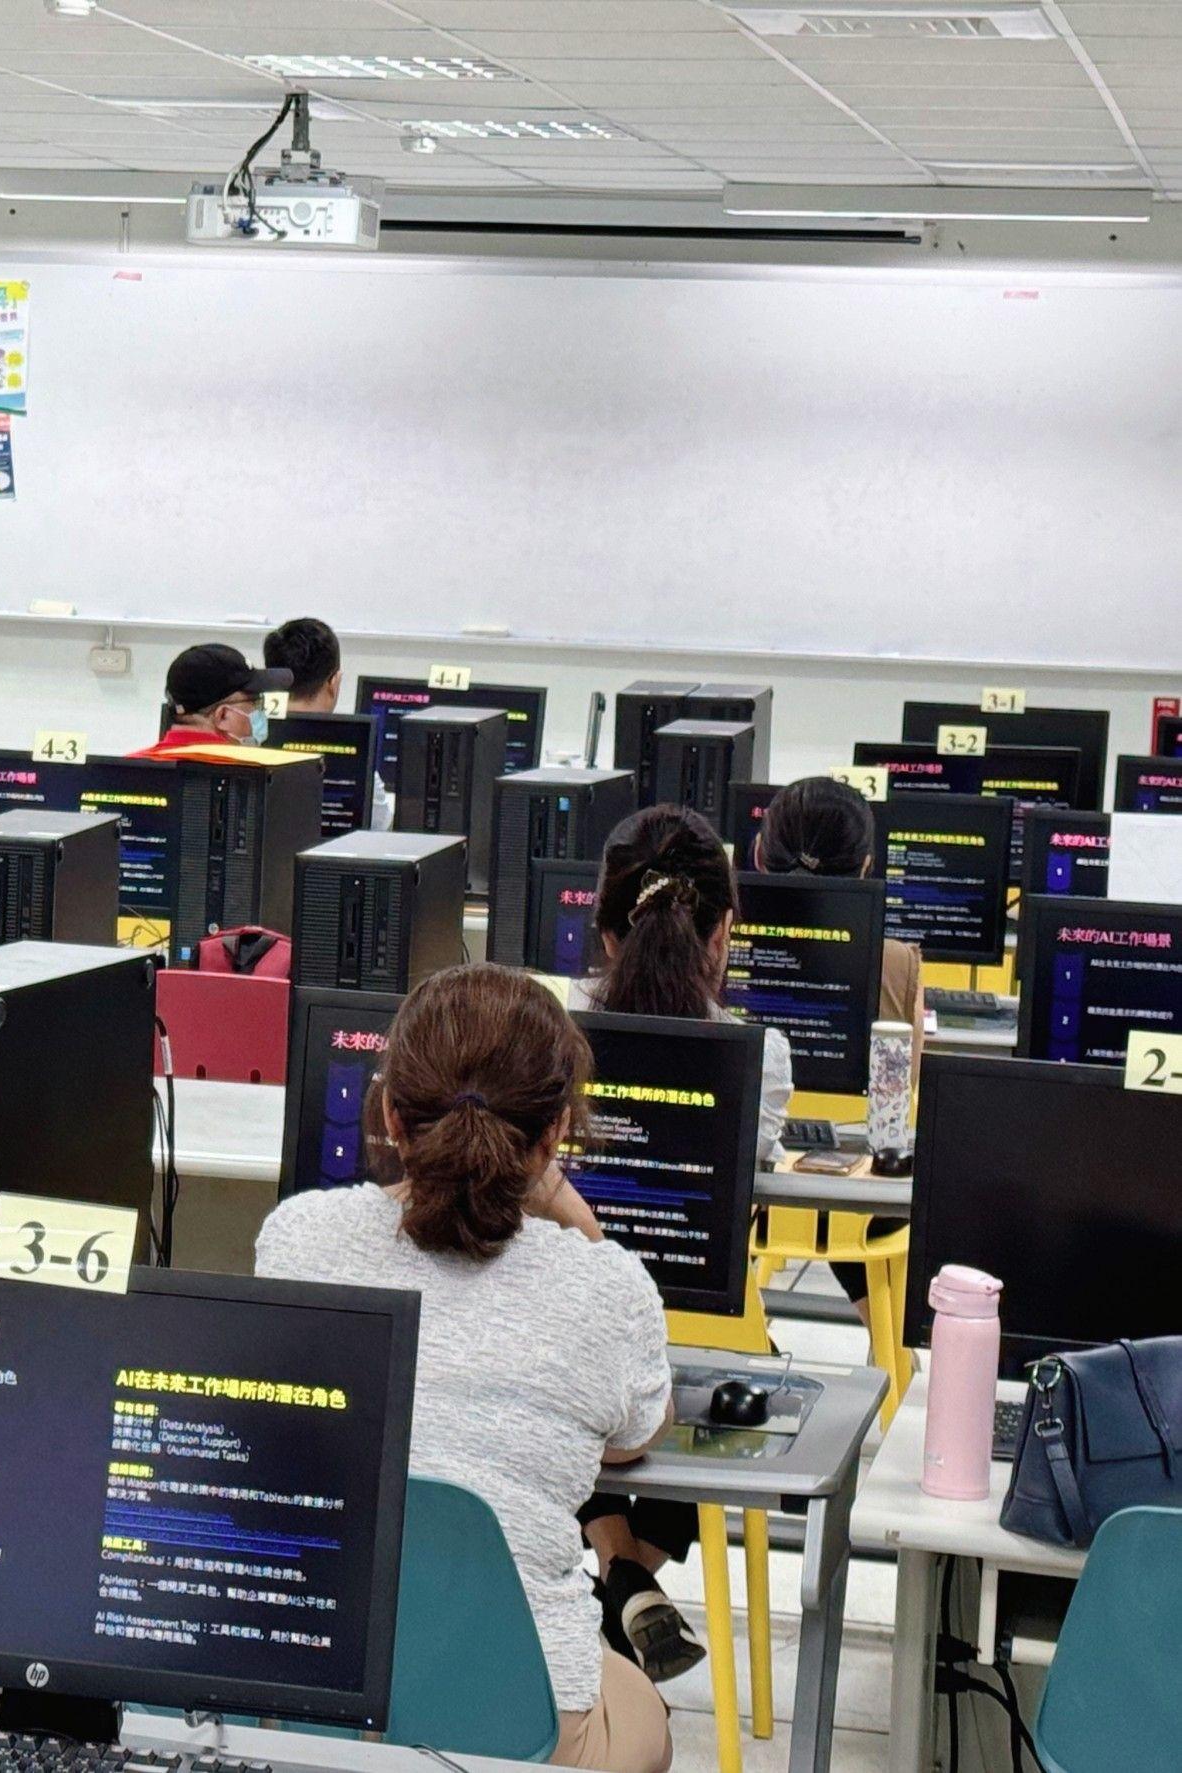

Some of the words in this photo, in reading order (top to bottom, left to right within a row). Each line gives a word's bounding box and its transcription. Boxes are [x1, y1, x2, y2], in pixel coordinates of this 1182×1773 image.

[434, 670, 462, 687] 4-1
[986, 693, 1016, 711] 3-1
[40, 738, 79, 762] 4-3
[944, 733, 978, 753] 3-2
[341, 1087, 348, 1099] 1
[335, 1145, 344, 1157] 2
[9, 1220, 115, 1284] 3-6
[115, 1368, 348, 1410] AI在未來工作場所的潛在角色
